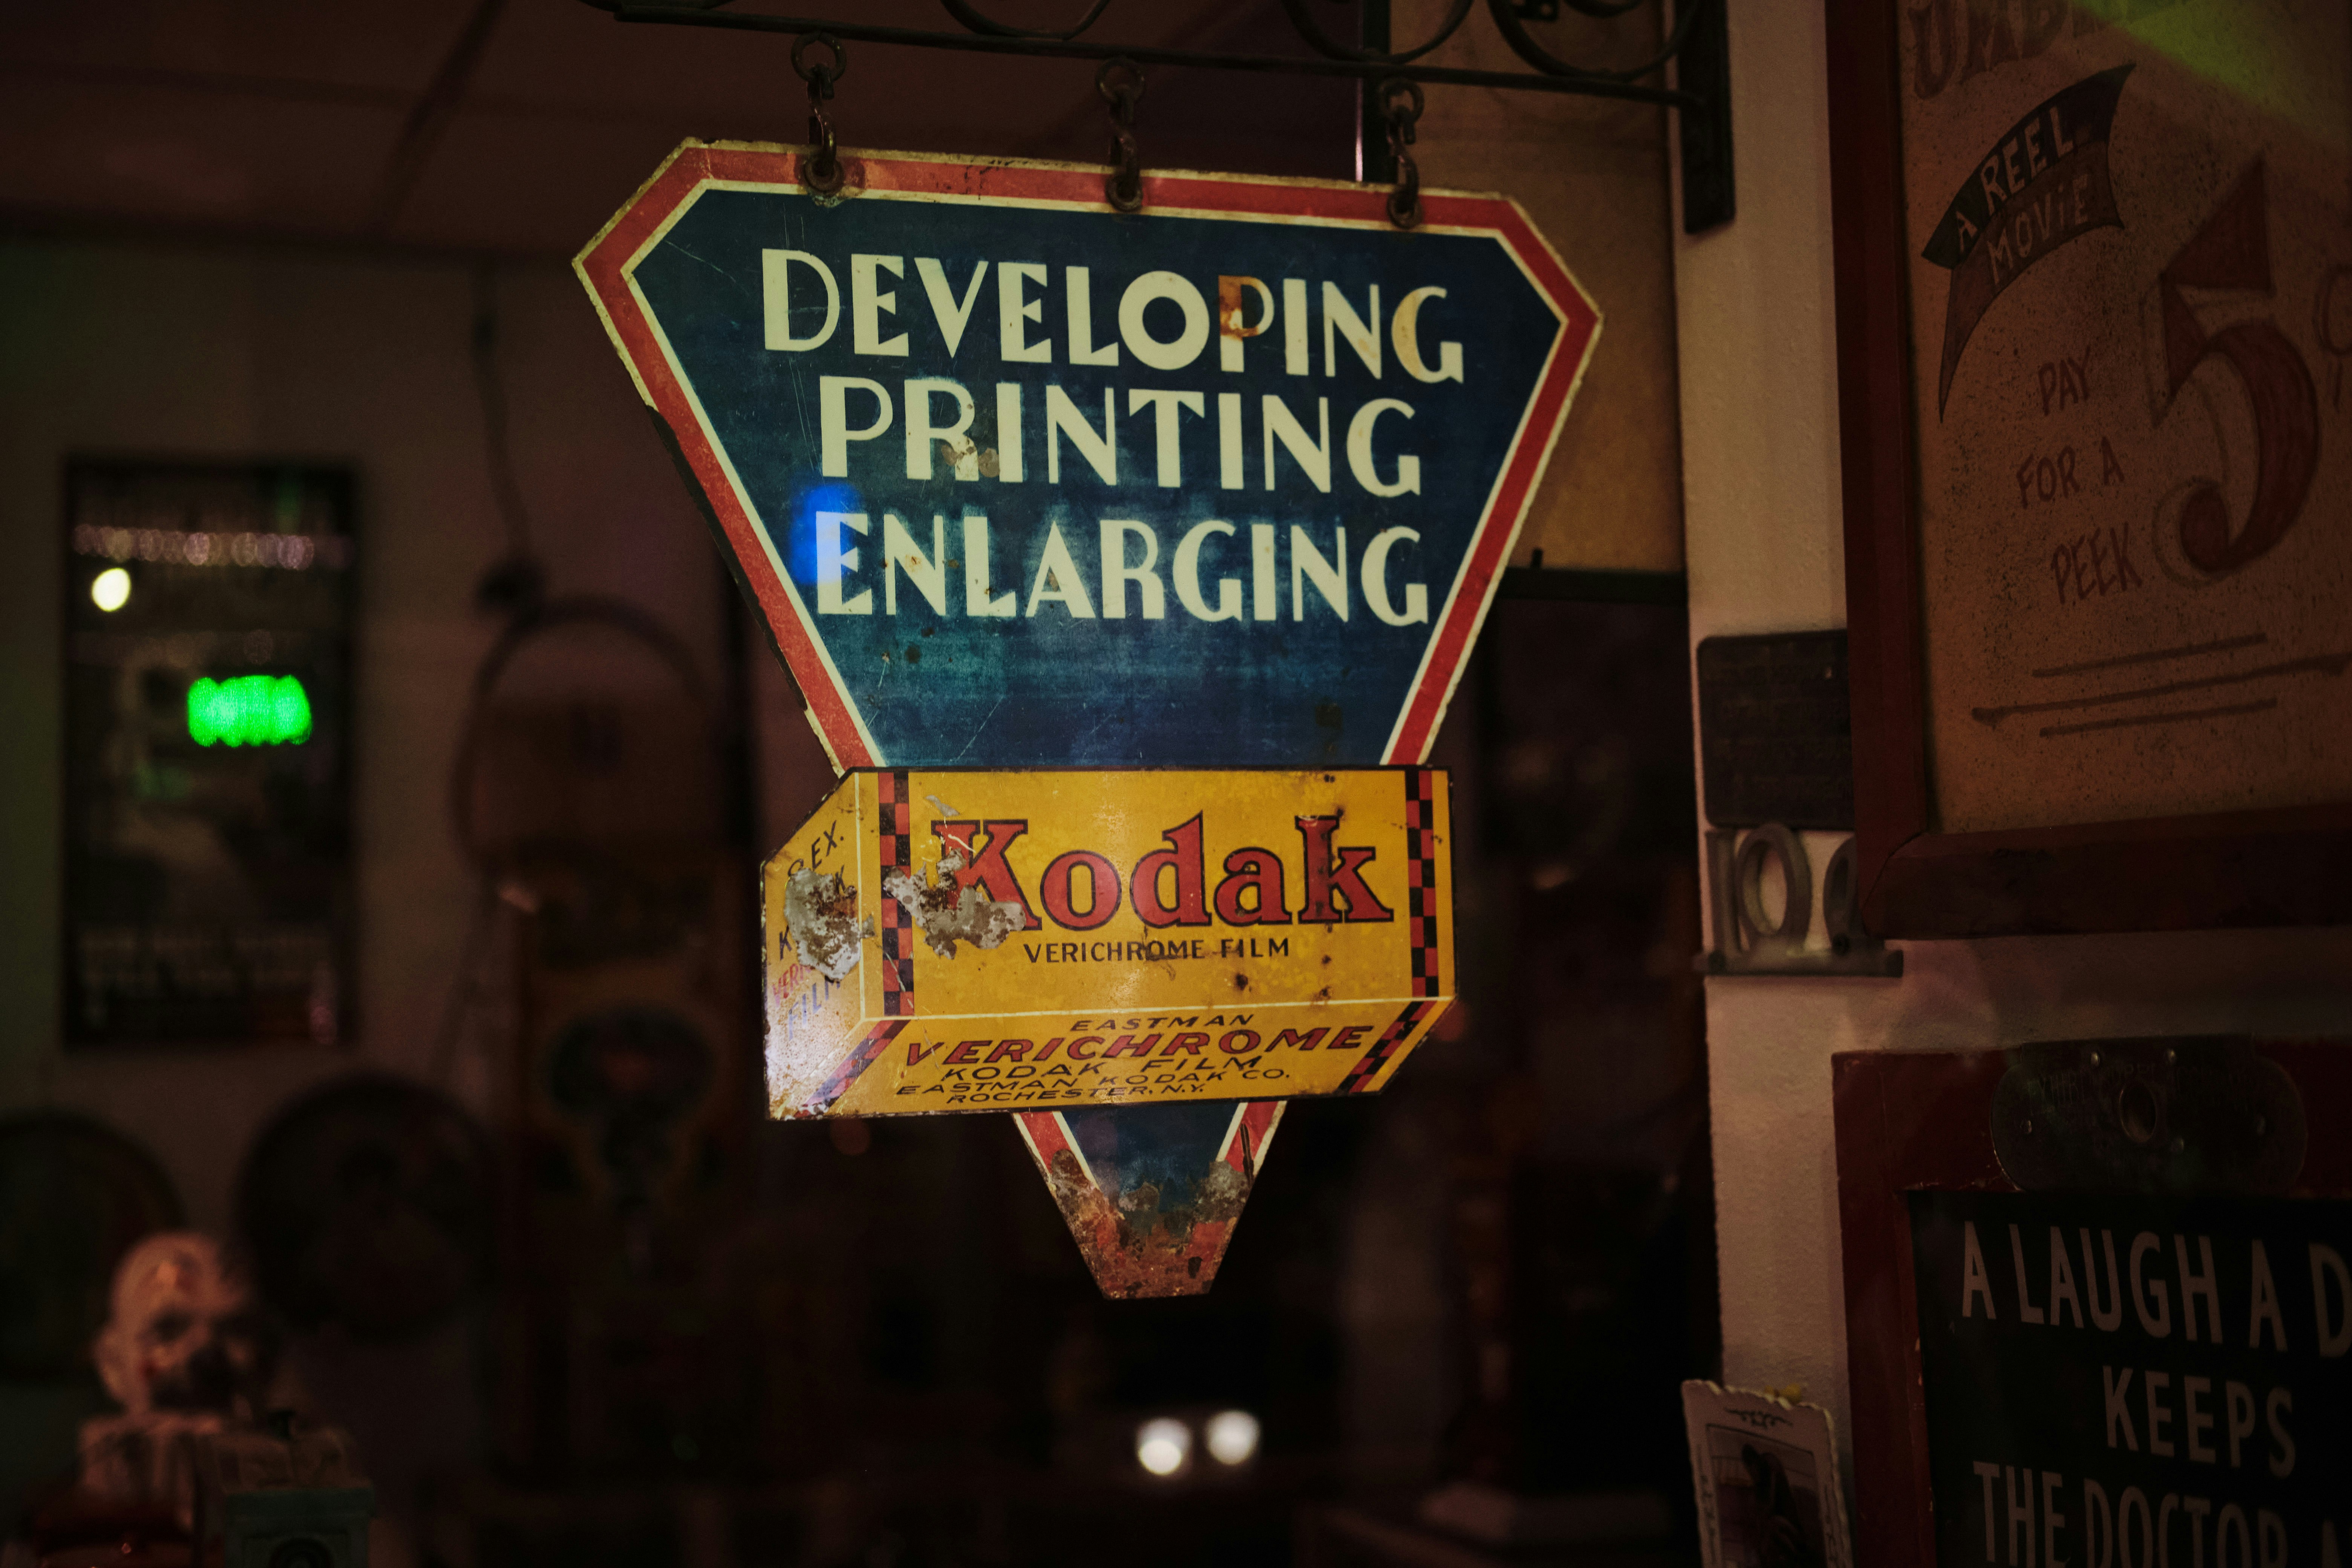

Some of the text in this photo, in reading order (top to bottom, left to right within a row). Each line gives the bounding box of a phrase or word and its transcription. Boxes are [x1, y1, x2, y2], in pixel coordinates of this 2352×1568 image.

[1957, 106, 2076, 253] A REEL
[763, 249, 1463, 383] DEVELOPING
[2038, 346, 2091, 416] PAY
[820, 376, 1421, 496] PRINTING
[2016, 436, 2125, 509] FOR A
[816, 511, 1427, 626] ENLARGING
[2050, 522, 2142, 603] PEEK
[931, 811, 1394, 931] Kodak
[1023, 938, 1289, 963] VERICHROME FILM
[906, 1026, 1375, 1066] VERICHROME
[941, 1056, 1262, 1081] KODAK FILM
[1070, 1015, 1254, 1032] EASTMAN
[897, 1069, 1290, 1095] EASTMAN KODAK CO.
[1962, 1221, 1997, 1319] A
[2009, 1224, 2223, 1344] LAUGH
[2249, 1239, 2289, 1352] A
[2103, 1366, 2296, 1479] KEEPS
[1972, 1461, 2067, 1568] THE
